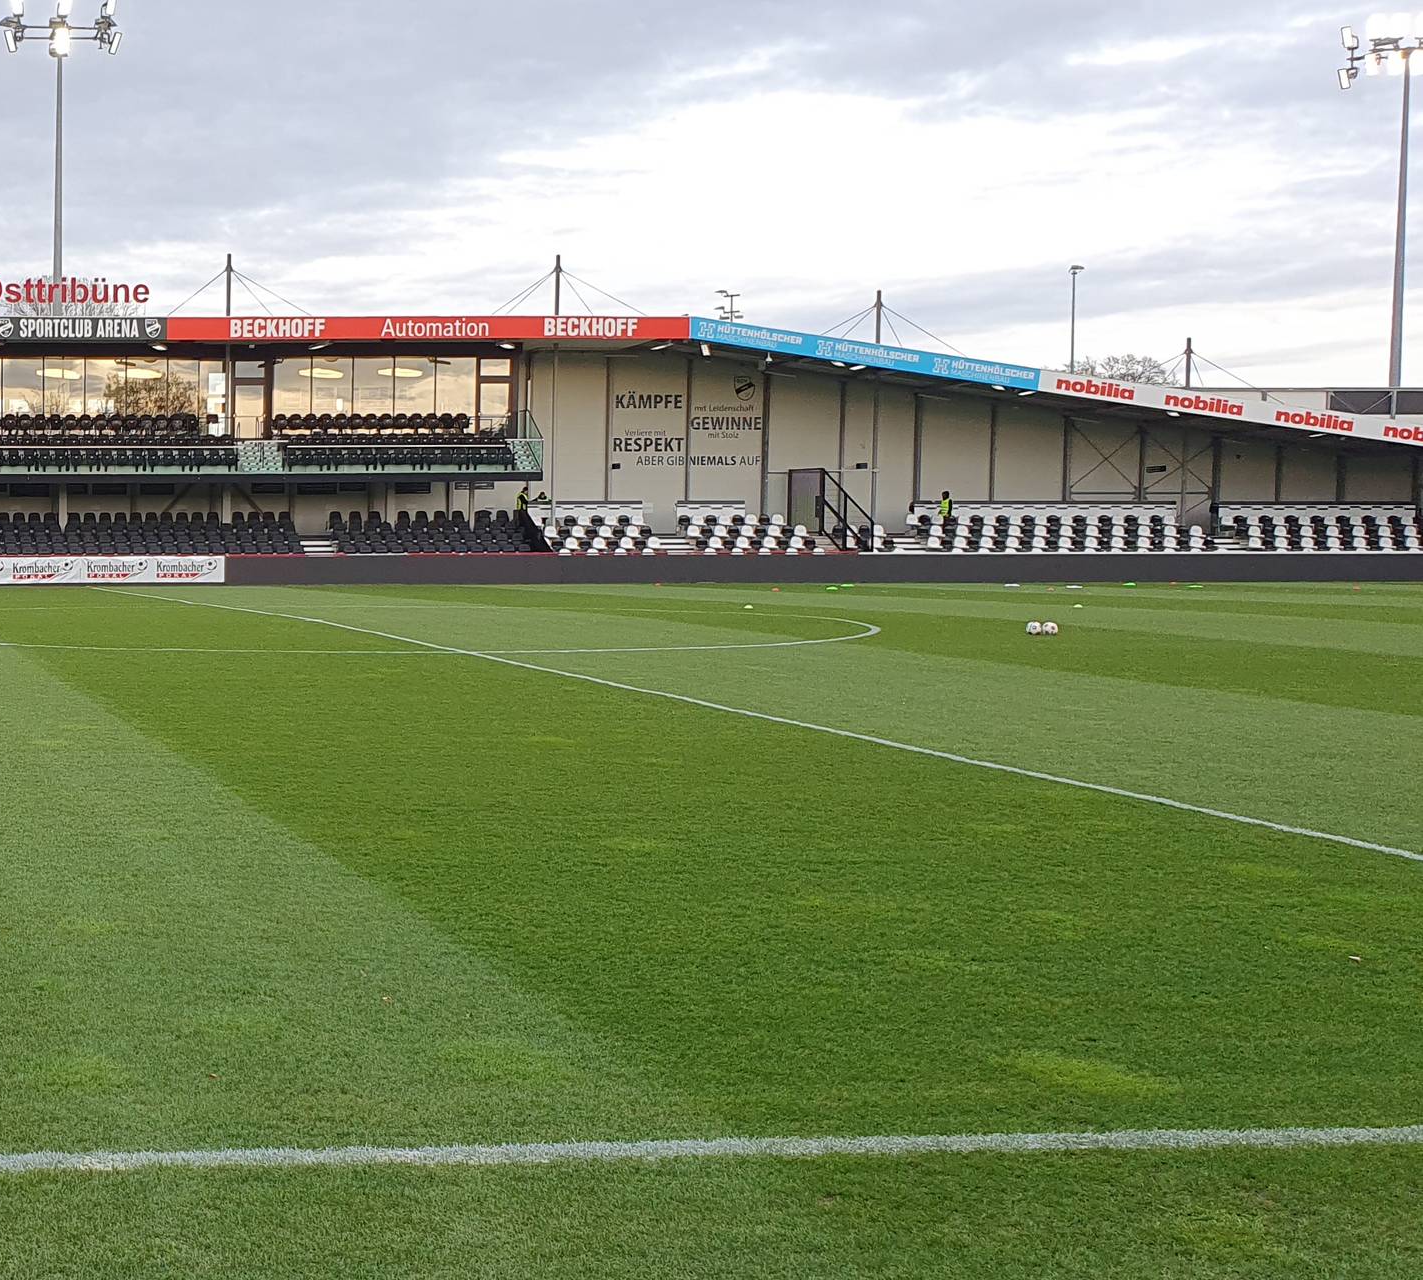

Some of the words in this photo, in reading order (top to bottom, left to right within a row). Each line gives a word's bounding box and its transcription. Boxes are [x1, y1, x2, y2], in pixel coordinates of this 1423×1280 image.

[19, 318, 93, 338] SPORTCLUB
[96, 318, 140, 338] ARENA
[230, 318, 326, 338] BECKHOFF
[381, 318, 489, 337] Automation
[543, 318, 638, 337] BECKHOFF
[717, 324, 803, 345] HÜTTENHÖLSCHER
[835, 343, 920, 363] HÜTTENHÖLSCHER
[951, 360, 1035, 379] HÜTTENHÖLSCHER
[1056, 378, 1135, 400] nobilia
[615, 391, 683, 409] KÄMPFE
[694, 404, 707, 412] mit
[709, 404, 754, 412] Leidenschaft
[1164, 394, 1244, 416] nobilia
[690, 416, 762, 431] GEWINNE
[1275, 410, 1354, 432] nobilia
[624, 429, 652, 437] Verliere
[654, 429, 667, 437] mit
[721, 431, 739, 439] Stolz
[613, 437, 684, 452] RESPEKT
[636, 455, 663, 466] ABER
[666, 455, 685, 466] GIB
[689, 456, 737, 466] NIEMALS
[739, 456, 761, 466] AUF
[12, 562, 60, 574] Krombacher
[87, 561, 135, 573] Krombacher
[157, 561, 204, 573] Krombacher
